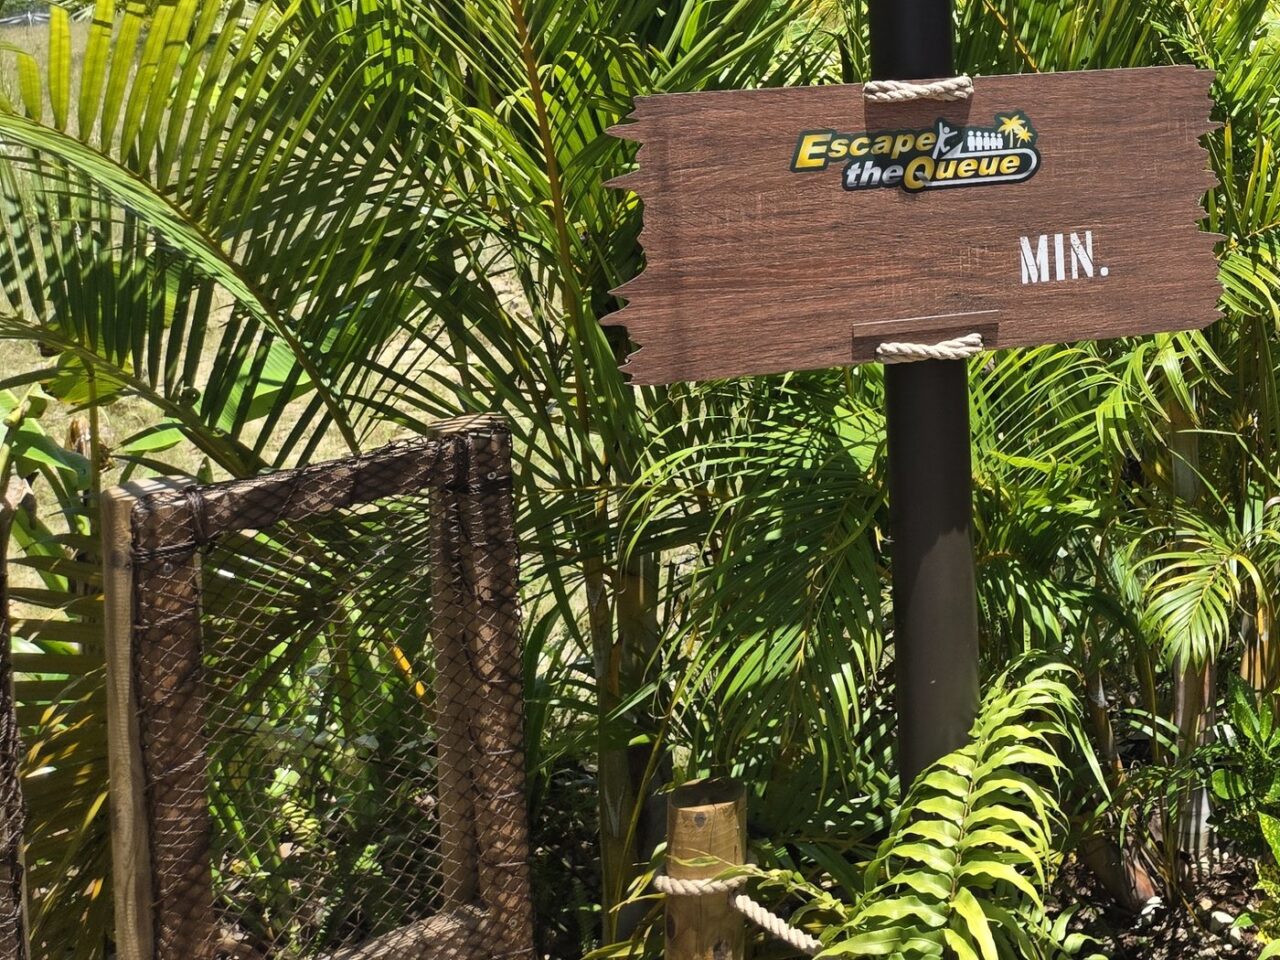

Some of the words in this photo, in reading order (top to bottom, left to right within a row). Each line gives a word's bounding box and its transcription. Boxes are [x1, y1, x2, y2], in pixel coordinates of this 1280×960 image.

[796, 130, 936, 169] Escape
[845, 156, 901, 189] the
[903, 153, 1021, 189] Queue
[1019, 230, 1109, 284] MIN.
